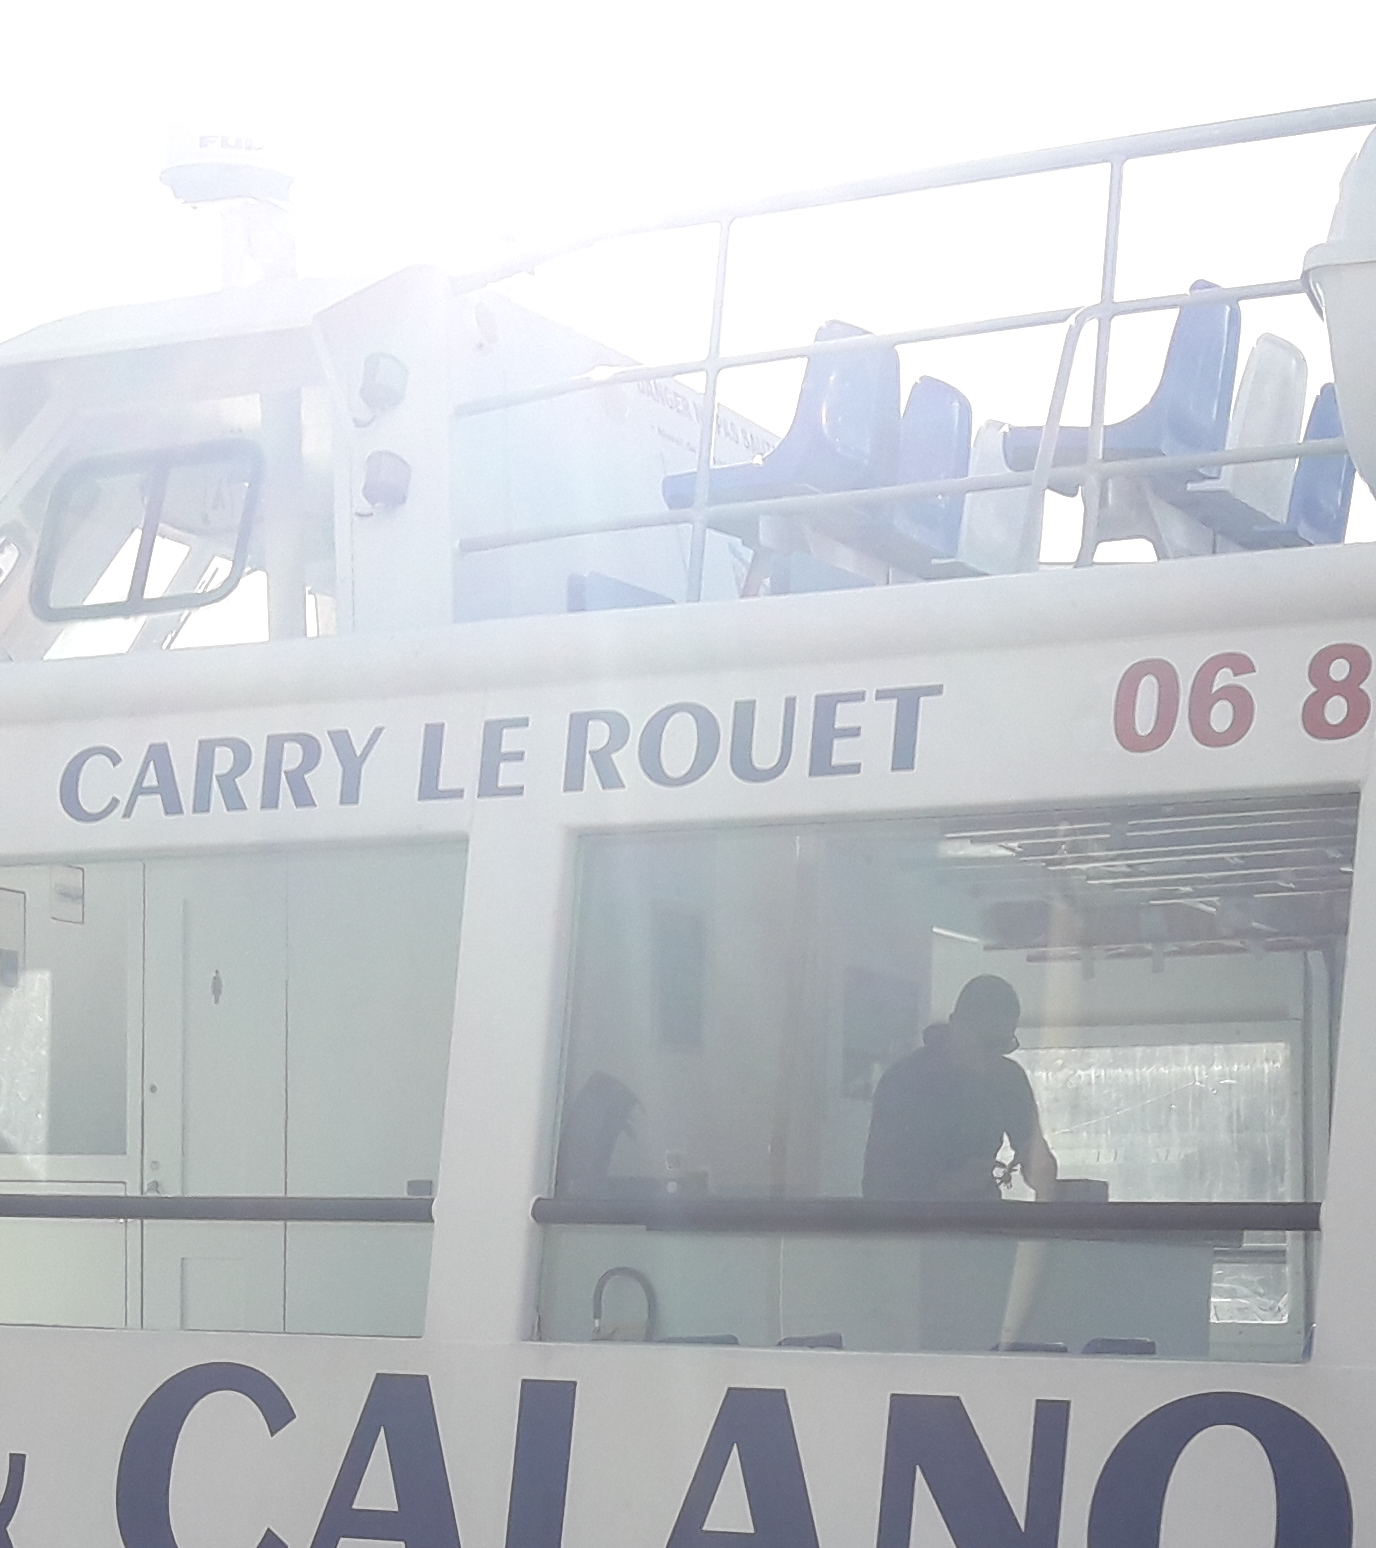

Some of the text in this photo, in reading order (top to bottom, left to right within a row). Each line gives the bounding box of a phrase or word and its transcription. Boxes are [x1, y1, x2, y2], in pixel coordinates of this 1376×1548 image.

[59, 683, 945, 824] CARRY LE ROUET
[1112, 650, 1256, 754] 06
